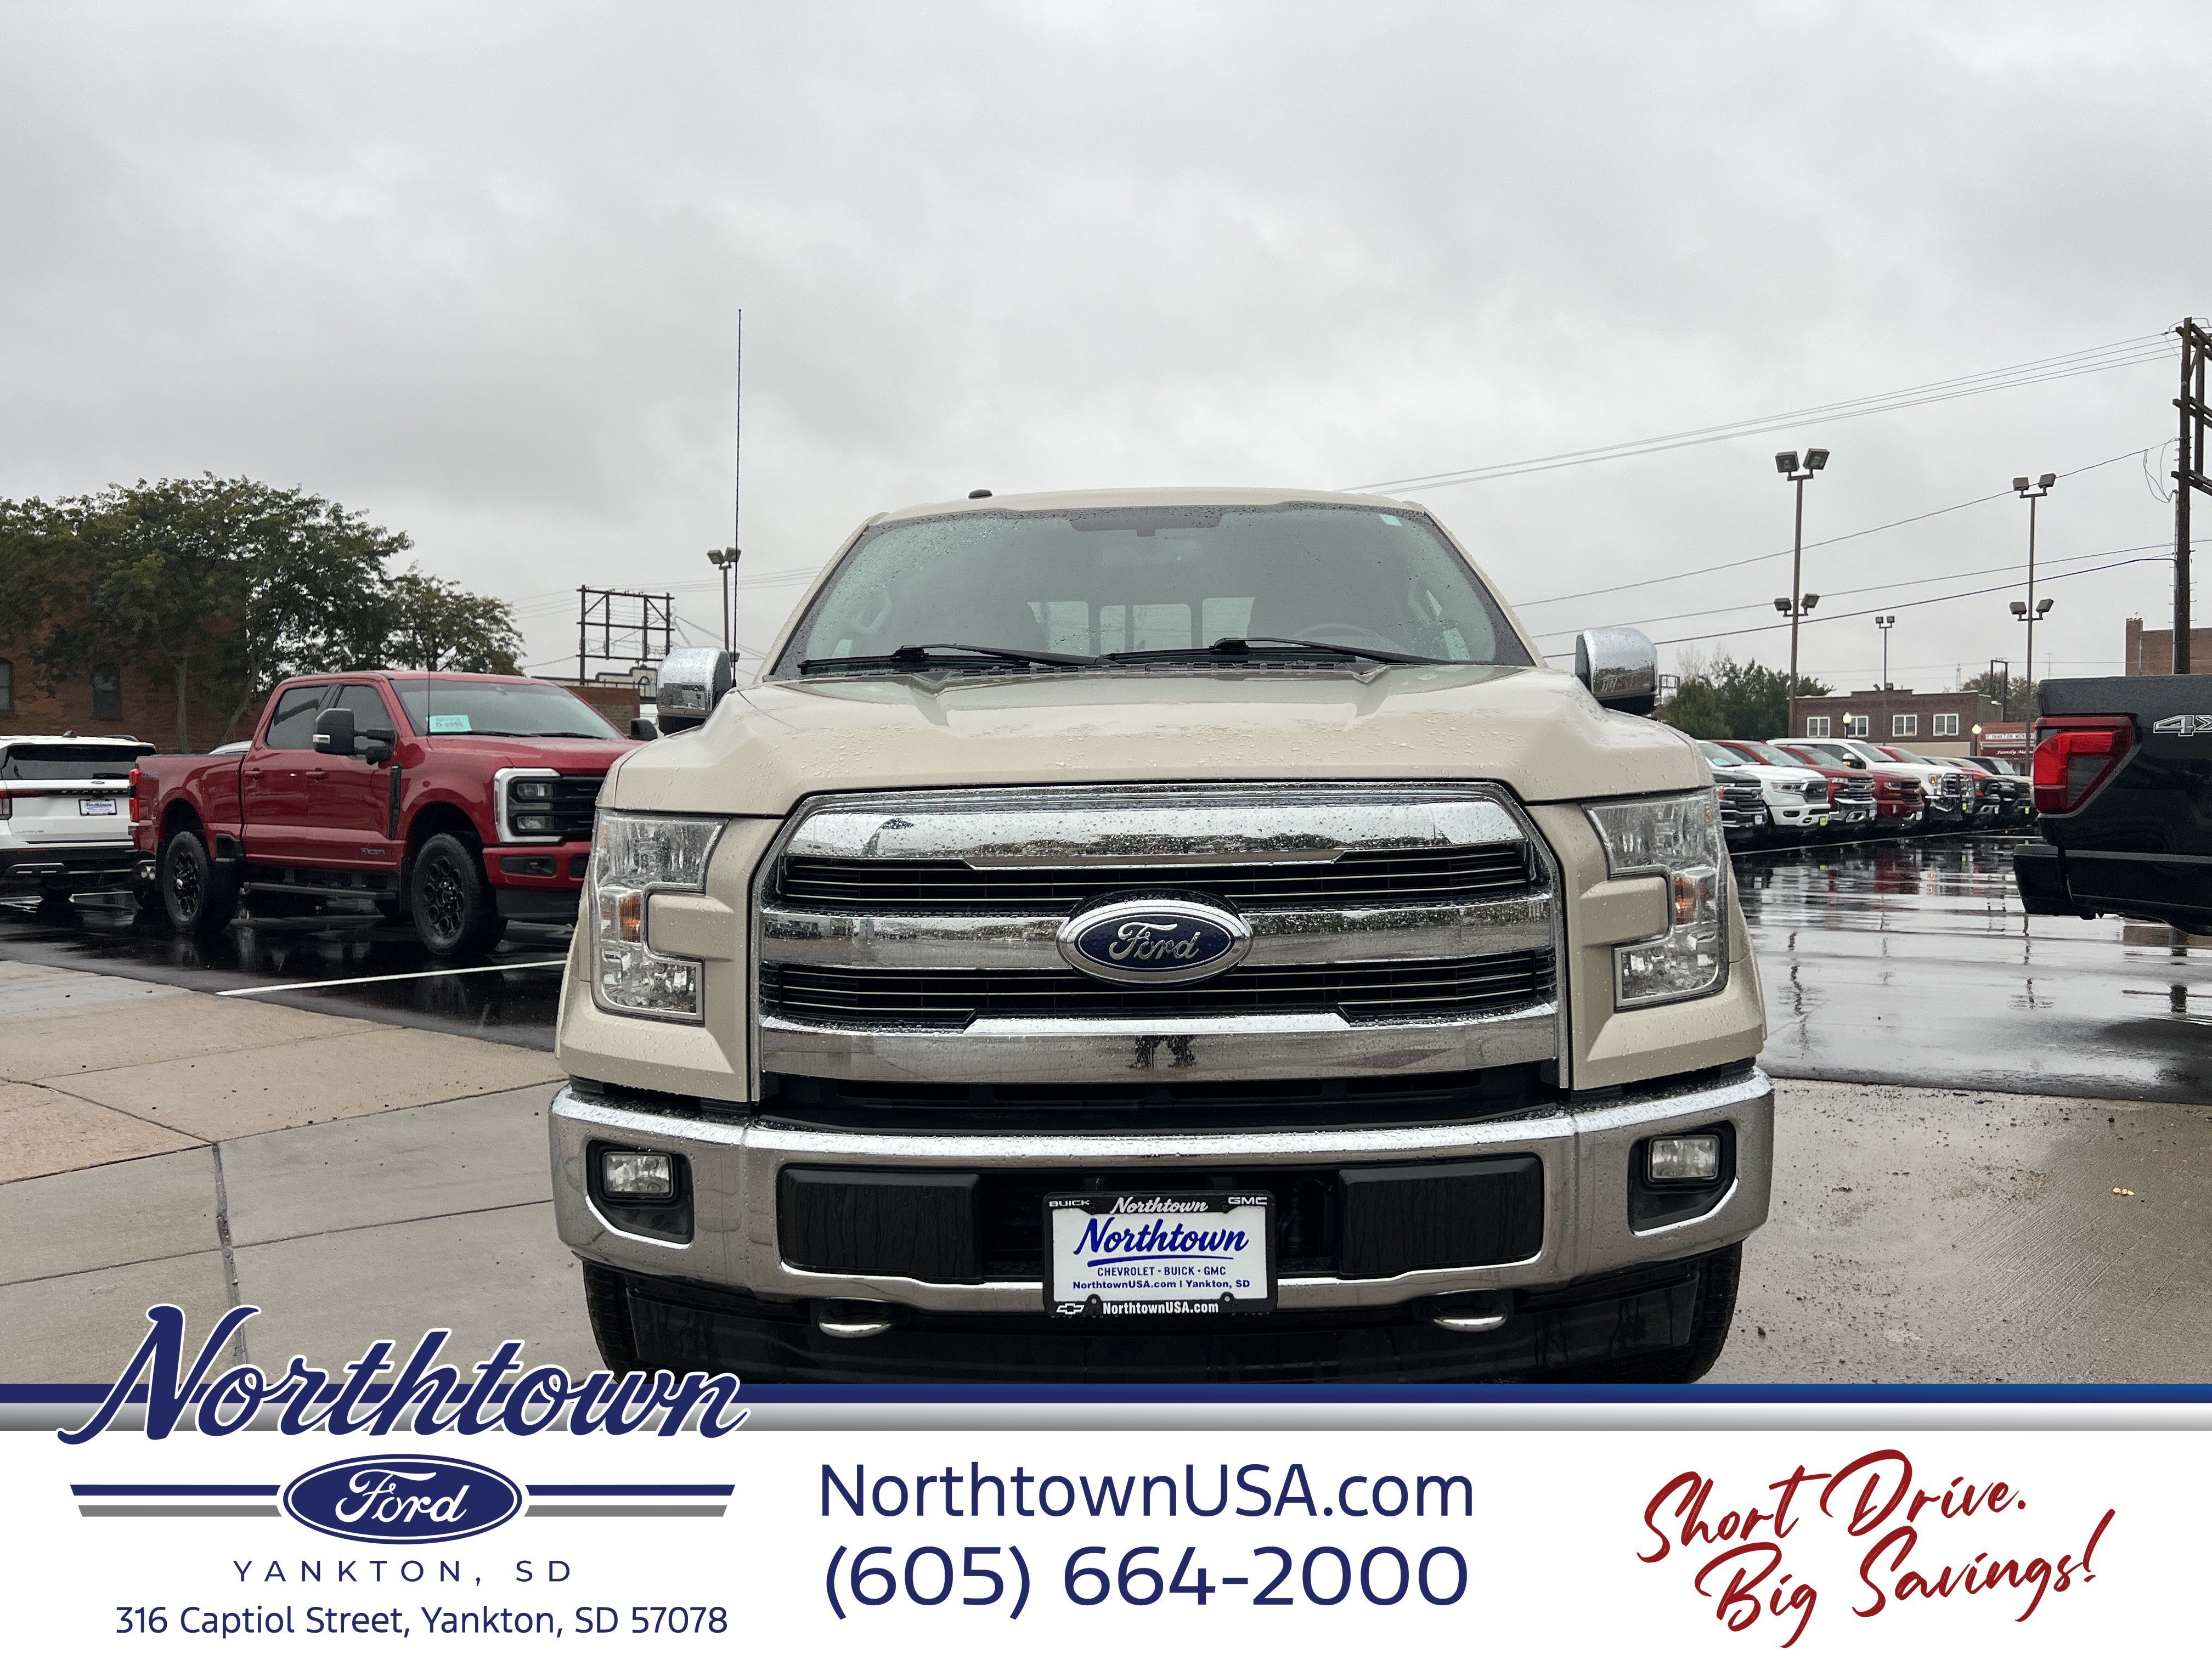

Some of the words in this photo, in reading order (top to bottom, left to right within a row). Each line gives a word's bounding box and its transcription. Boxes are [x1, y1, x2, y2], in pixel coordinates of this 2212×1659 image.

[1109, 922, 1201, 960] Ford
[1048, 1199, 1091, 1207] BUICK
[1109, 1196, 1209, 1215] Northtown
[1228, 1197, 1267, 1205] GMC
[1073, 1216, 1249, 1255] Northtown
[1097, 1266, 1155, 1276] CHEVROLET
[1164, 1265, 1195, 1276] BUICK
[1204, 1265, 1226, 1276] GMC
[1073, 1280, 1176, 1290] NorthtownUSA.com
[1187, 1279, 1232, 1289] Yankton,
[1235, 1279, 1250, 1288] SD
[1103, 1301, 1218, 1315] NorthtownUSA.com
